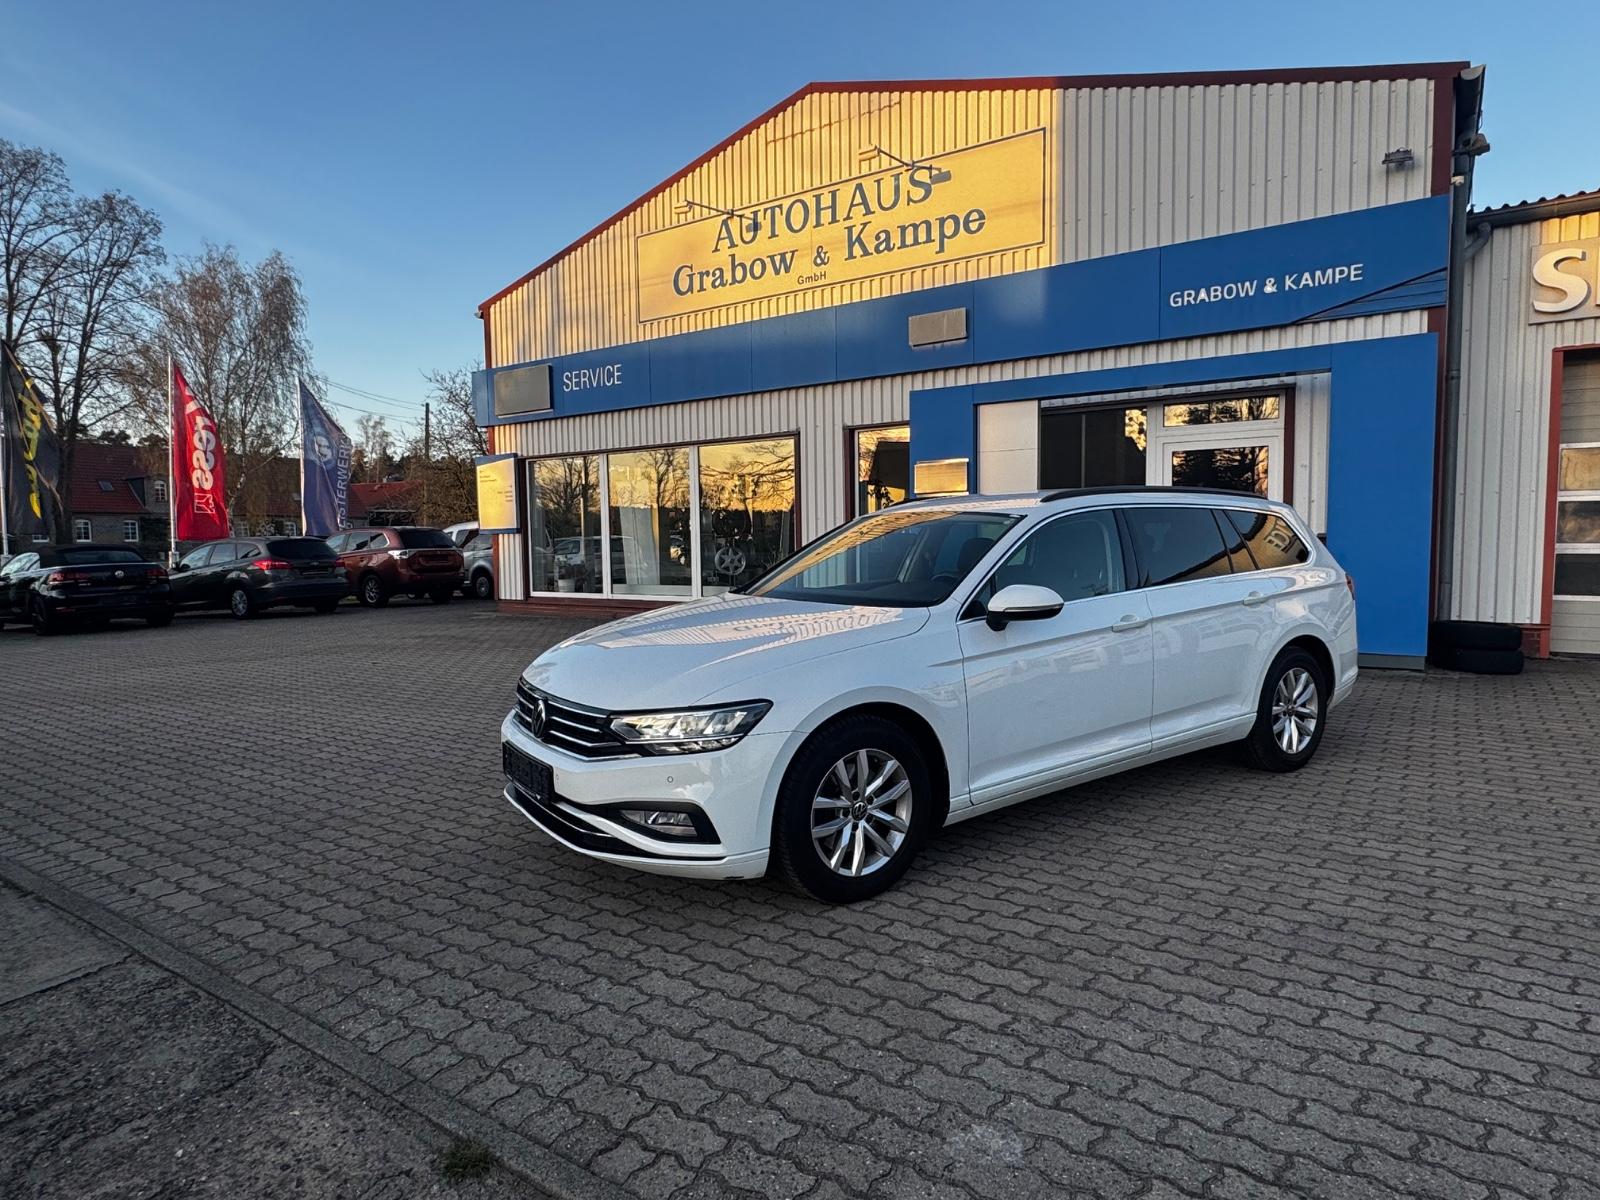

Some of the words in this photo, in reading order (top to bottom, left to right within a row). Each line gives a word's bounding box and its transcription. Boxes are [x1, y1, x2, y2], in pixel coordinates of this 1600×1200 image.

[712, 166, 934, 253] AUTOHAUS
[673, 249, 798, 297] Grabow
[813, 245, 830, 267] &
[844, 208, 986, 262] Kampe
[797, 271, 828, 286] GmbH
[1169, 279, 1258, 308] GRABOW
[1263, 276, 1279, 294] &
[1284, 263, 1365, 291] KAMPE
[562, 364, 623, 393] SERVICE
